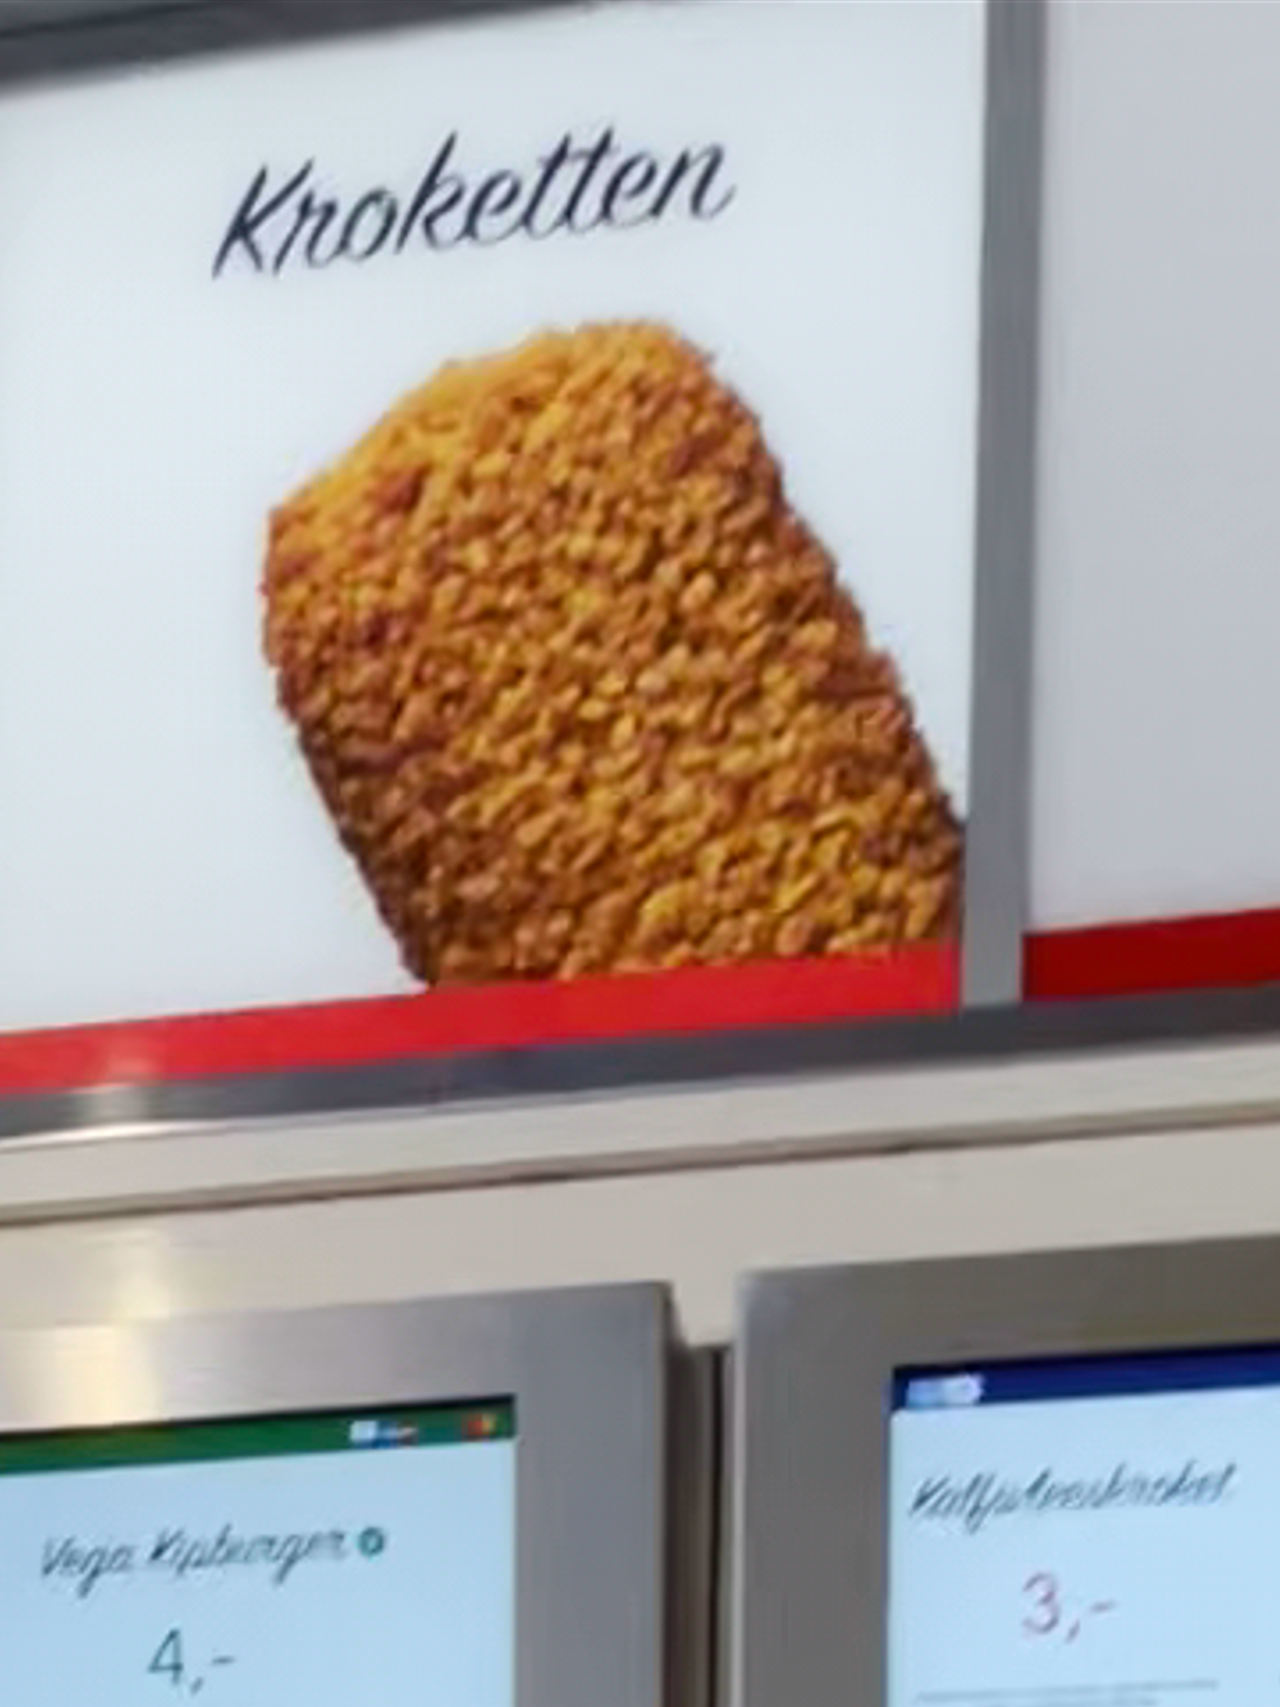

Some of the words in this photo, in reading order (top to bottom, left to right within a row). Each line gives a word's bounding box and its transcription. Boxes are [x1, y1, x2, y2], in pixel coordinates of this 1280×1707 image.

[210, 125, 738, 281] Kroketten
[1019, 1571, 1118, 1644] 3,-
[146, 1628, 237, 1696] 4,-
